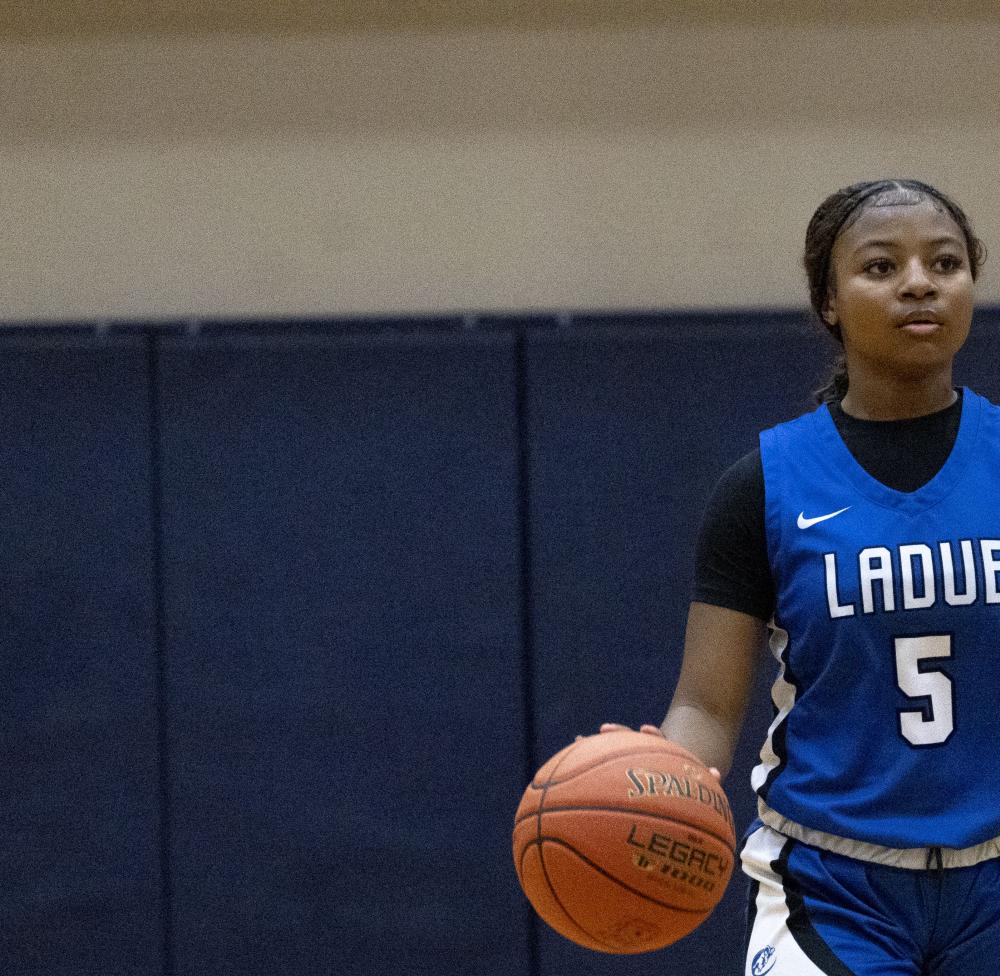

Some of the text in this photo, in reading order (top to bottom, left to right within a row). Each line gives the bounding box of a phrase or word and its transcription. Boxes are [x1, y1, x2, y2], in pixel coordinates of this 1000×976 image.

[893, 633, 955, 747] 5
[625, 766, 733, 826] SPALDIN
[627, 823, 729, 876] LEGACY
